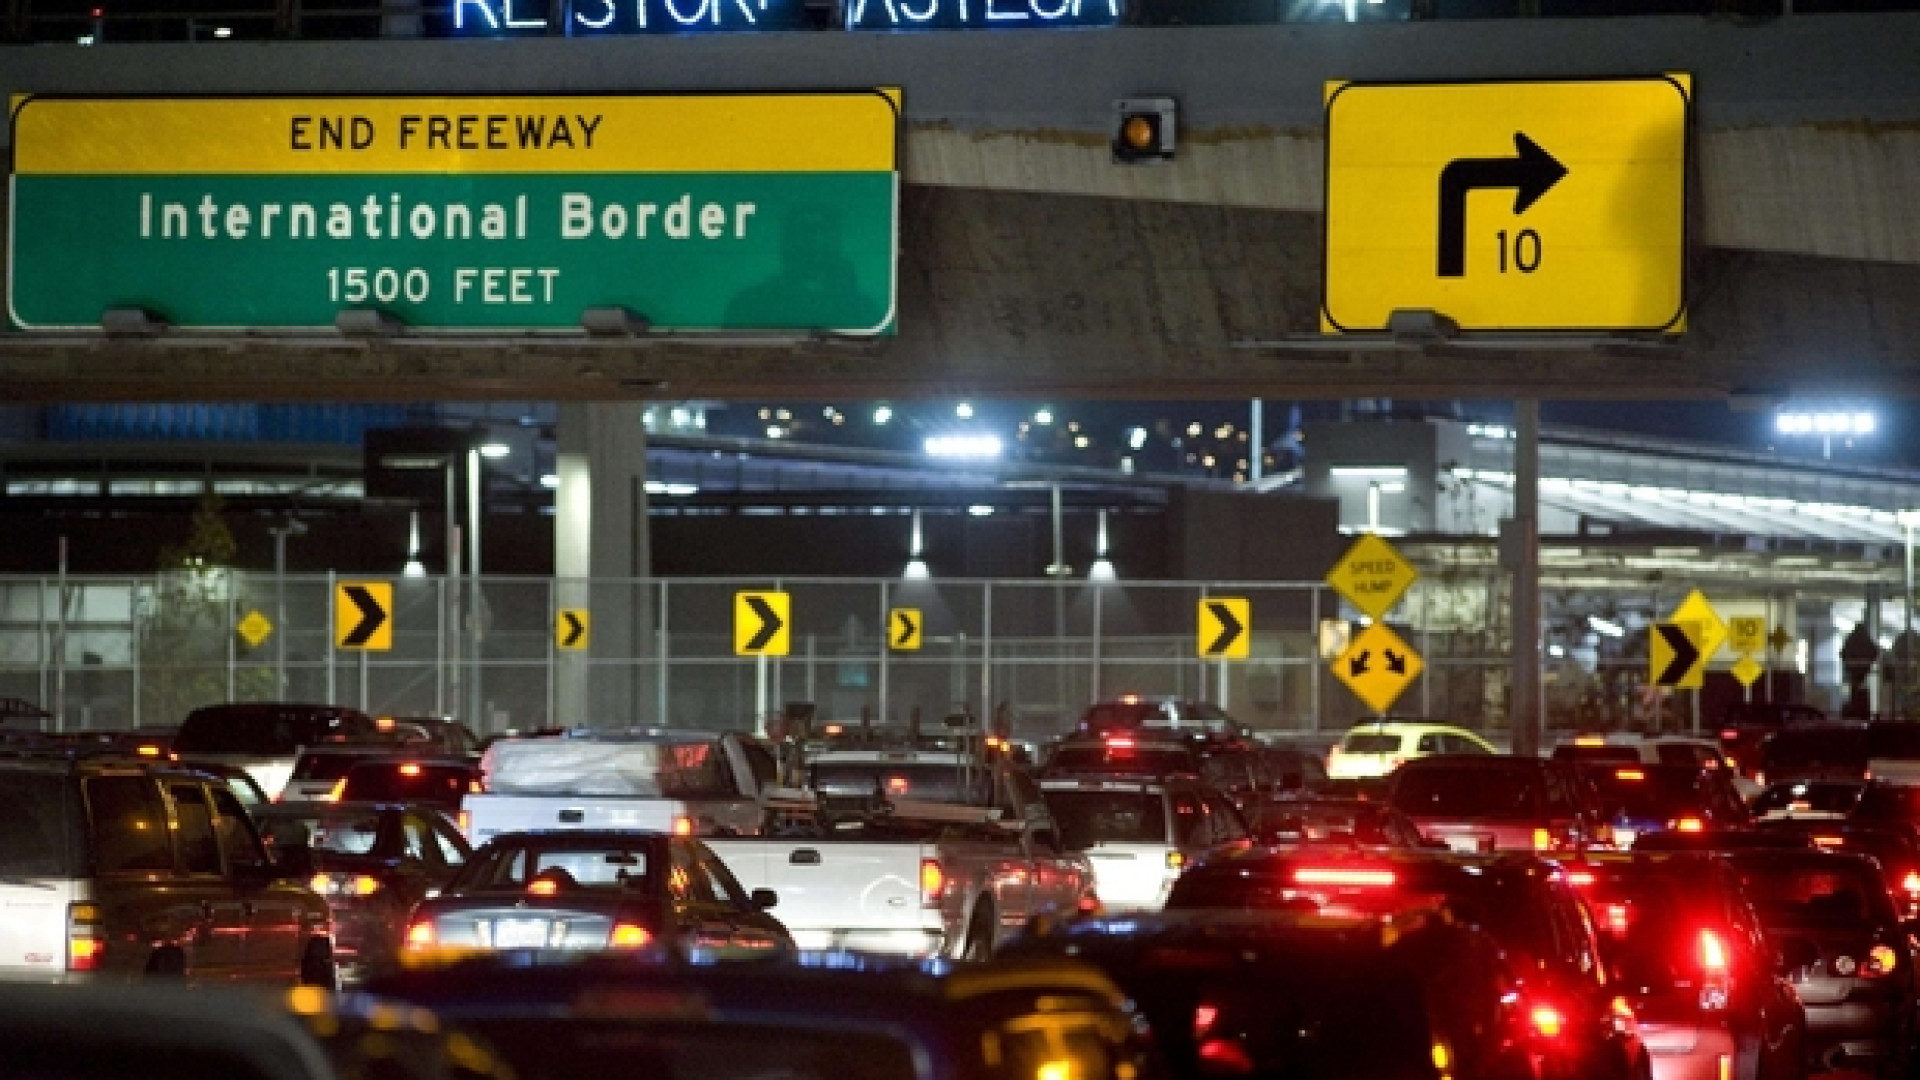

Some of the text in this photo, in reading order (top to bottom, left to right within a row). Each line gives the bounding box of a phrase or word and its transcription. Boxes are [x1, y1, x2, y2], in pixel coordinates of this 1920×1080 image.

[290, 113, 604, 151] END FREEWAY
[139, 192, 757, 240] International Border
[1496, 227, 1543, 274] 10
[327, 267, 561, 302] 1500 FEET
